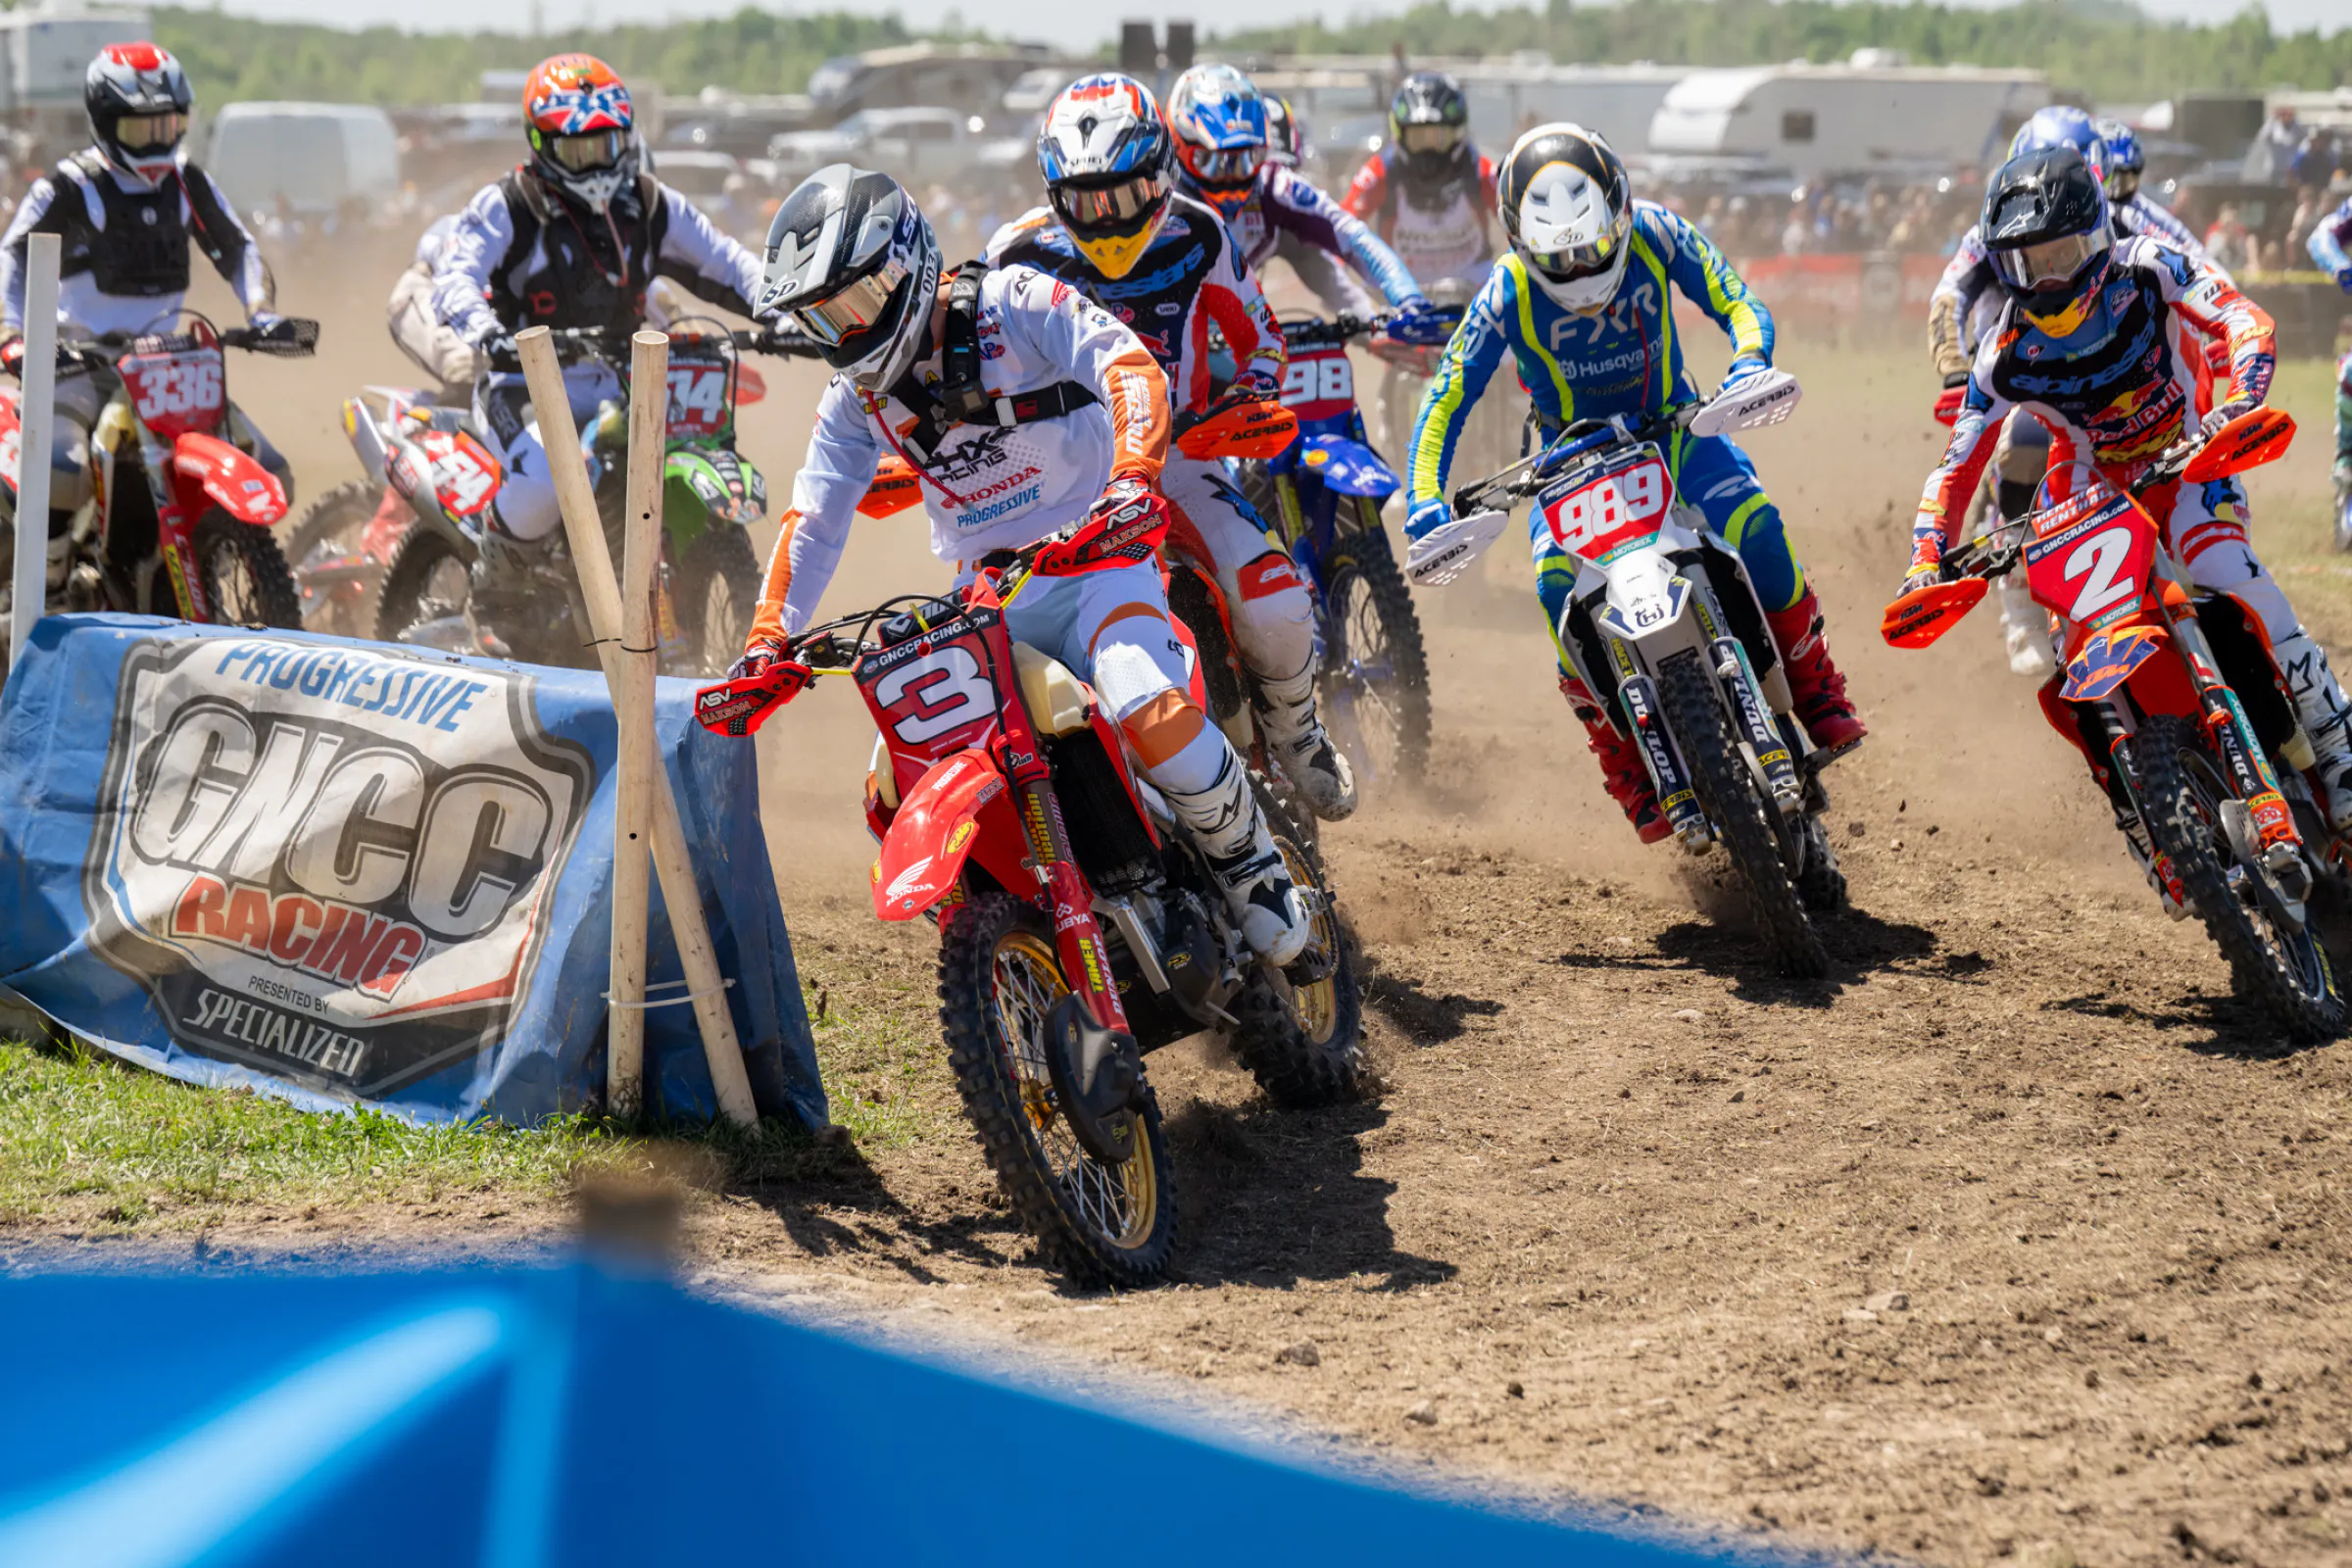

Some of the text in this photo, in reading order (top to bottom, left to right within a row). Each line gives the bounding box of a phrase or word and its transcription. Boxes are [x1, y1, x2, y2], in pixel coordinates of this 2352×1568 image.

[922, 254, 936, 295] 003
[1548, 281, 1658, 352] FXR
[1579, 333, 1664, 377] Husqvana
[137, 362, 223, 420] 336
[1280, 357, 1353, 409] 98
[1738, 384, 1795, 417] ACERBIS
[1229, 421, 1295, 443] ACERBIS
[2084, 377, 2184, 444] Red Bull
[956, 484, 1042, 528] PROGRESSIVE
[961, 466, 1043, 504] HONDA
[1558, 462, 1664, 554] 989
[1098, 513, 1163, 555] MAKSON
[1106, 498, 1152, 530] ASV
[2042, 500, 2131, 555] GNCCRACING.COM
[1413, 544, 1468, 579] ACERBIS
[2063, 525, 2135, 623] 2
[1888, 608, 1945, 641] ACERBIS
[2101, 598, 2138, 626] MOTOREX
[215, 642, 488, 733] PROGRESSIVE
[699, 687, 732, 710] ASV
[874, 644, 997, 746] 3
[1719, 644, 1770, 744] DUNLP
[700, 700, 752, 725] MAKSON
[1626, 686, 1678, 784] DULOP
[2230, 695, 2265, 761] MOTOREX
[134, 702, 552, 939] GNCC
[885, 882, 937, 908] HONDA
[174, 874, 426, 997] RACING
[1055, 911, 1091, 936] UBYA
[247, 975, 330, 1015] PRESENTED BY
[1092, 933, 1124, 1016] DUNLOP
[182, 987, 365, 1079] SPECIALIZED
